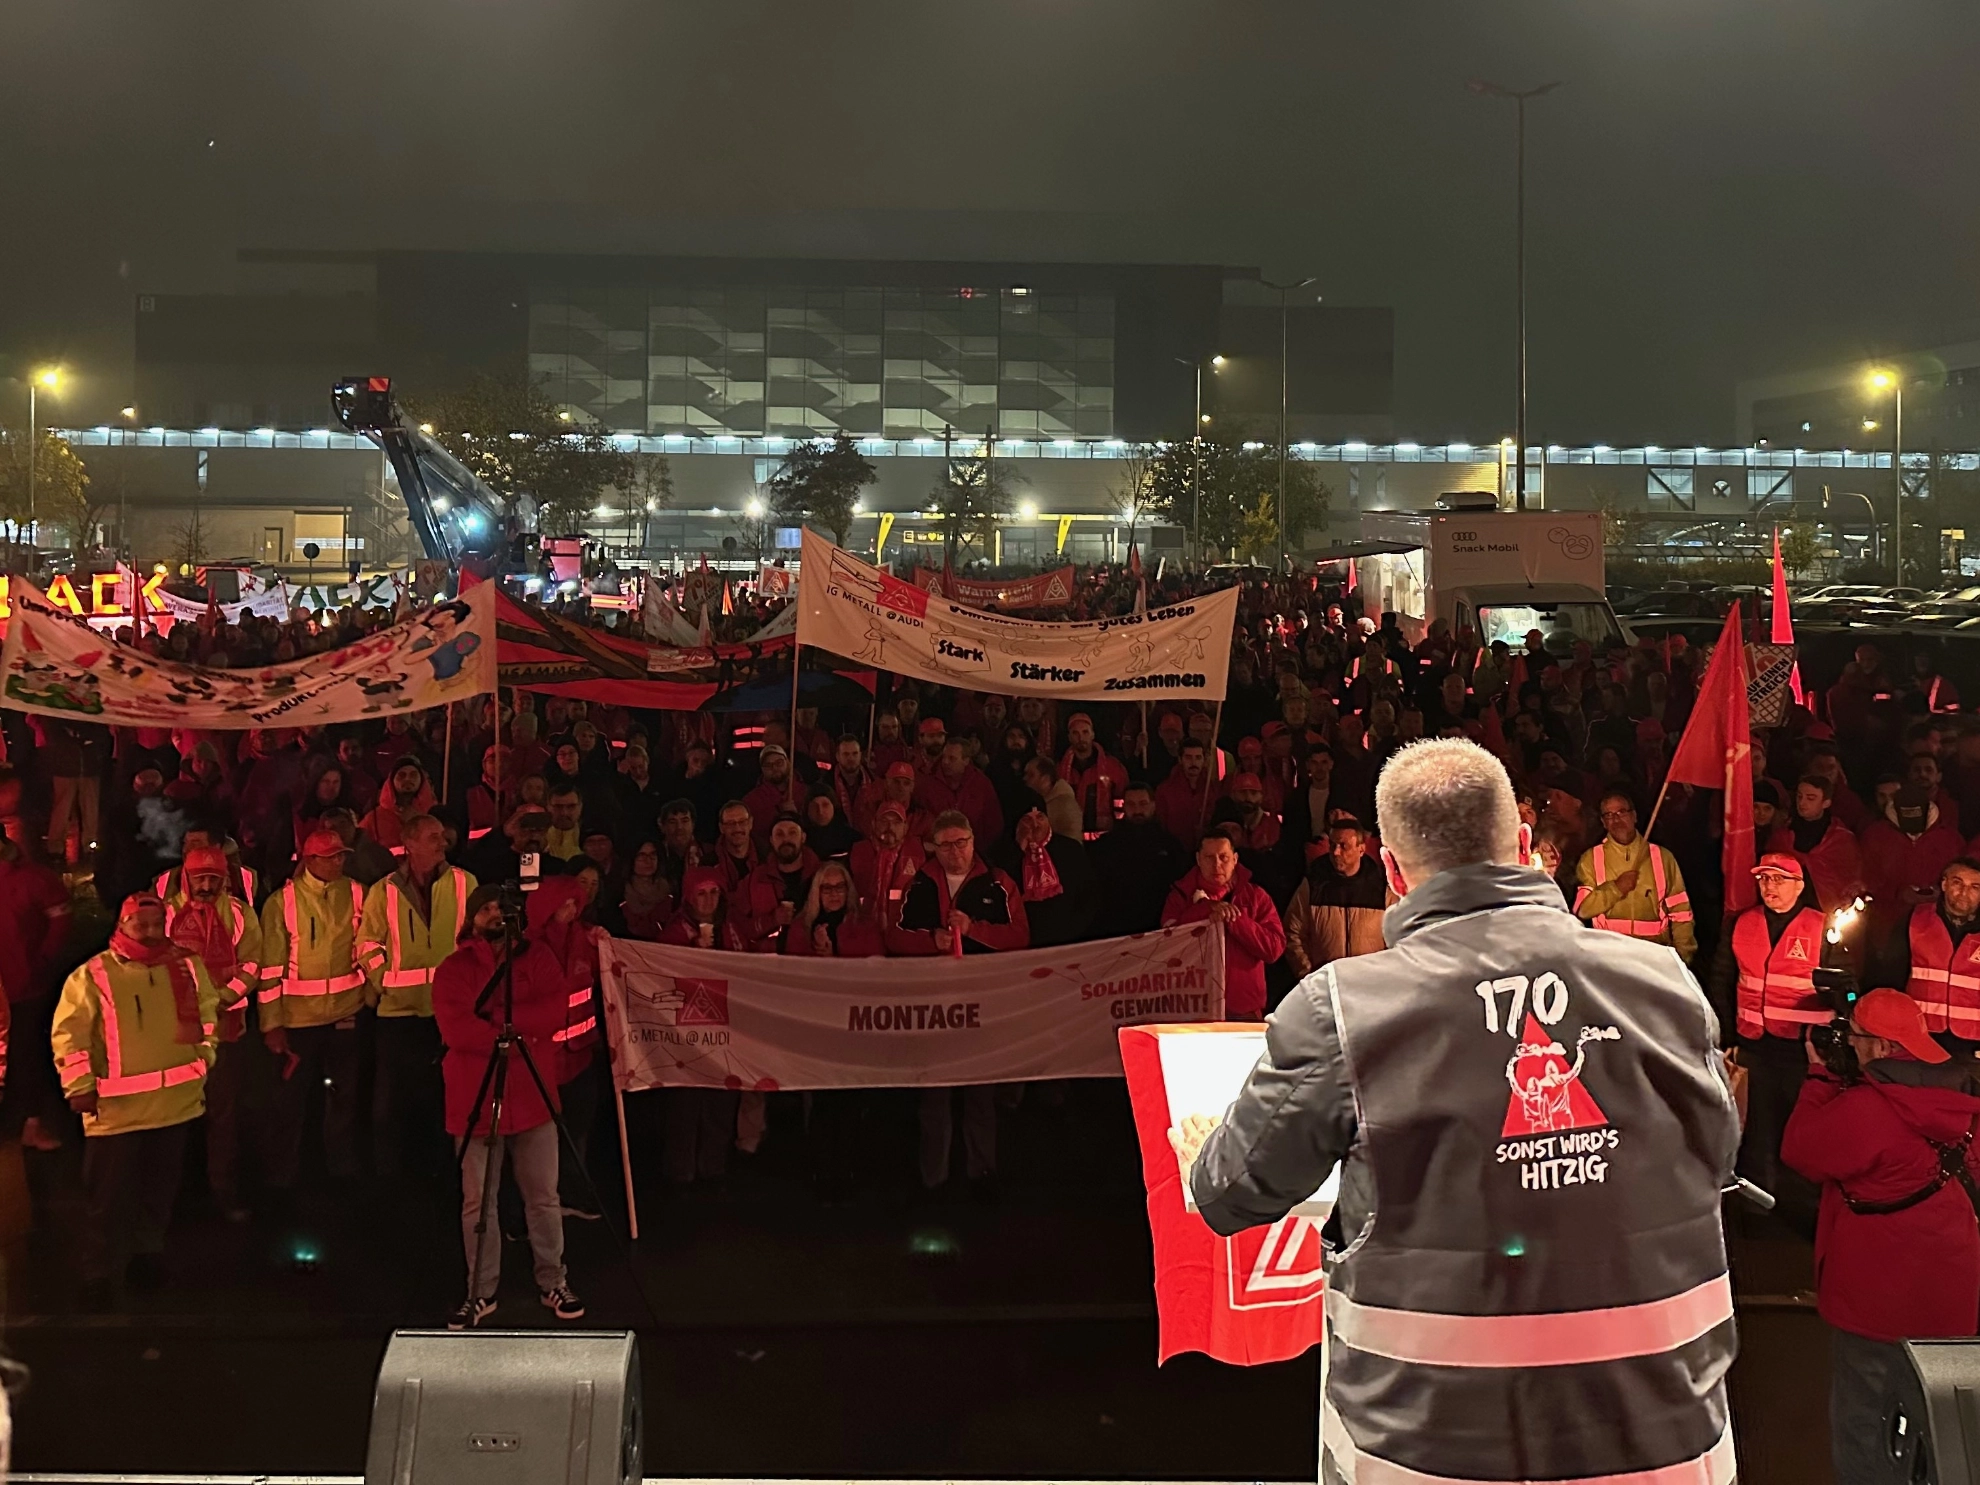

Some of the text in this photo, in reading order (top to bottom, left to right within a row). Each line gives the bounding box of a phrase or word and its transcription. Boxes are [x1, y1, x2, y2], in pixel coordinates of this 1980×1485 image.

[1452, 543, 1519, 553] Snack Mobil
[827, 585, 837, 596] IG
[842, 591, 881, 616] METALL
[1147, 605, 1195, 622] Leben
[938, 639, 984, 662] Stark
[498, 665, 590, 677] USAMMEN
[1010, 661, 1085, 682] Stärker
[1759, 658, 1790, 684] EINEN
[1749, 670, 1790, 704] STREICH
[1081, 965, 1208, 1001] SOLIDARITÄT
[849, 1003, 980, 1031] MONTAGE
[1111, 993, 1208, 1019] GEWINNT!
[1475, 971, 1569, 1039] 170
[628, 1029, 730, 1046] IG METALL @ AUDI
[1496, 1129, 1620, 1163] SONST WIRD'S
[1521, 1153, 1609, 1190] HITZIG
